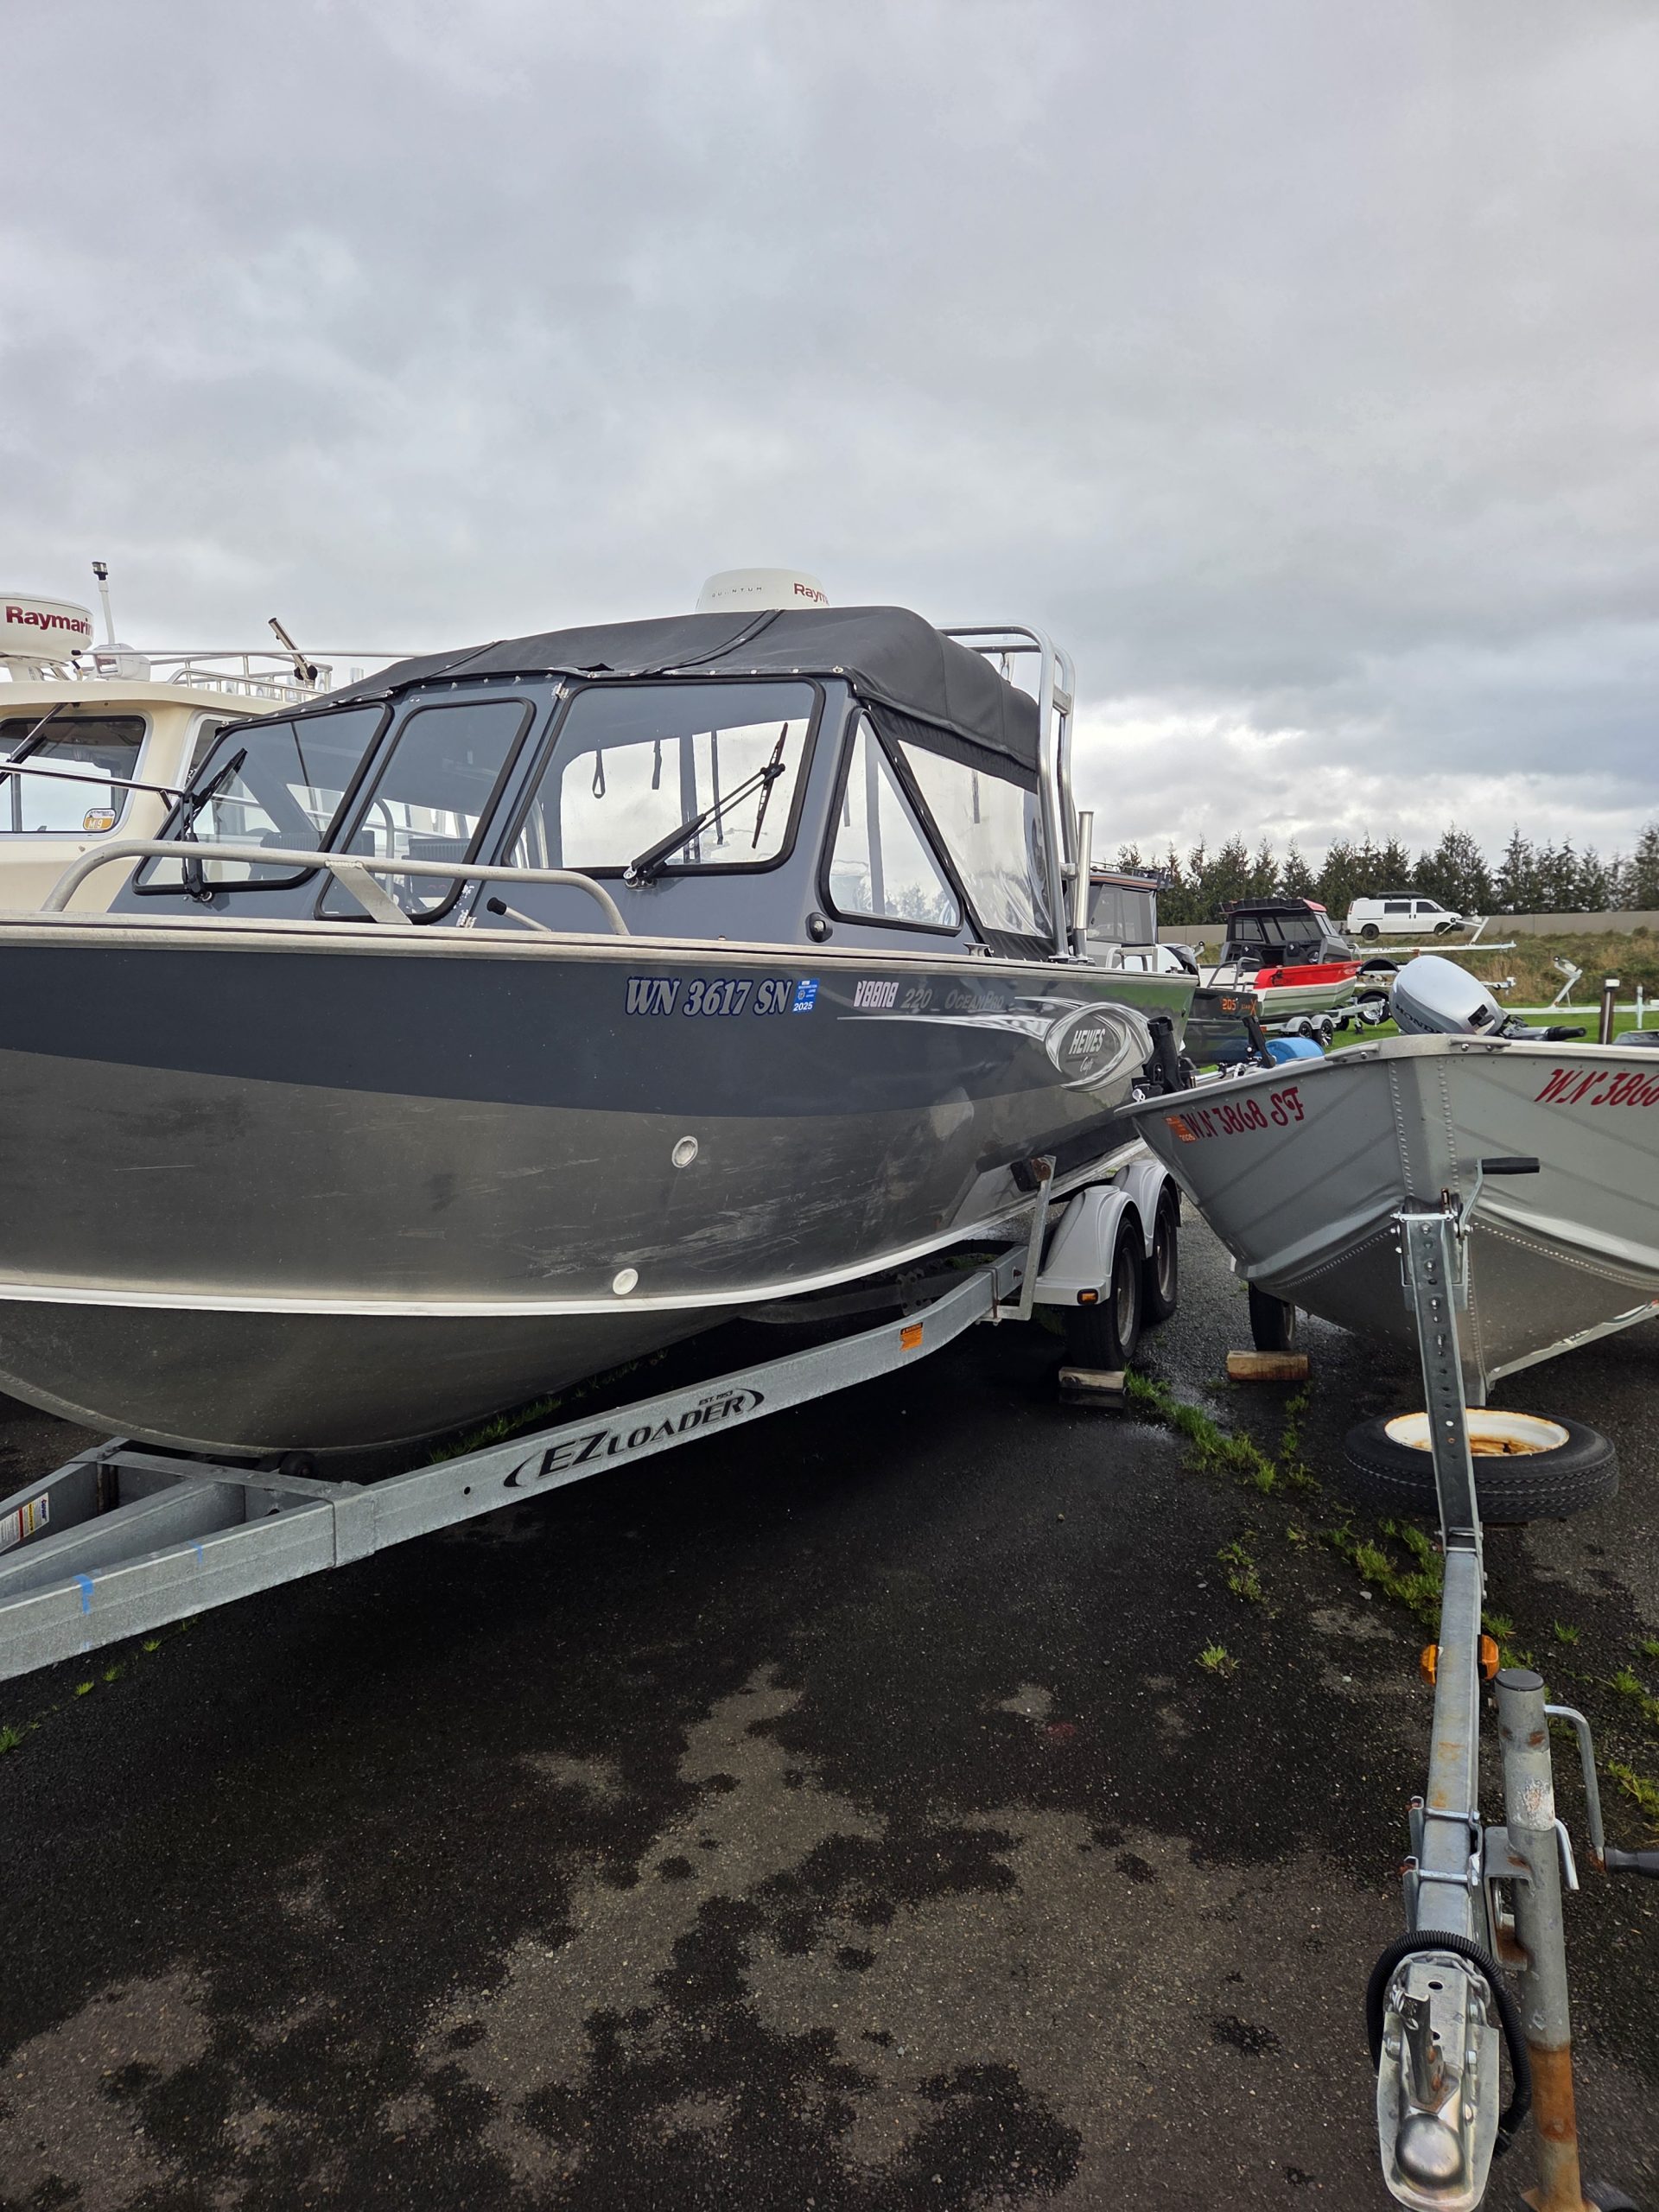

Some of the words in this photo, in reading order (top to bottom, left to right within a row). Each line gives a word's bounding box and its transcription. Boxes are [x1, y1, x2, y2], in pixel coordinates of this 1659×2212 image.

[793, 582, 830, 606] Raym
[626, 976, 682, 1015] WN
[683, 978, 753, 1017] 3617
[753, 978, 792, 1014] SN
[792, 1001, 814, 1012] 2025
[900, 988, 932, 1010] 220
[1068, 1028, 1106, 1055] HEWES
[1533, 1068, 1609, 1105] WN
[1179, 1109, 1219, 1140] WN
[1211, 1098, 1269, 1135] 3868
[1270, 1086, 1306, 1127] SF
